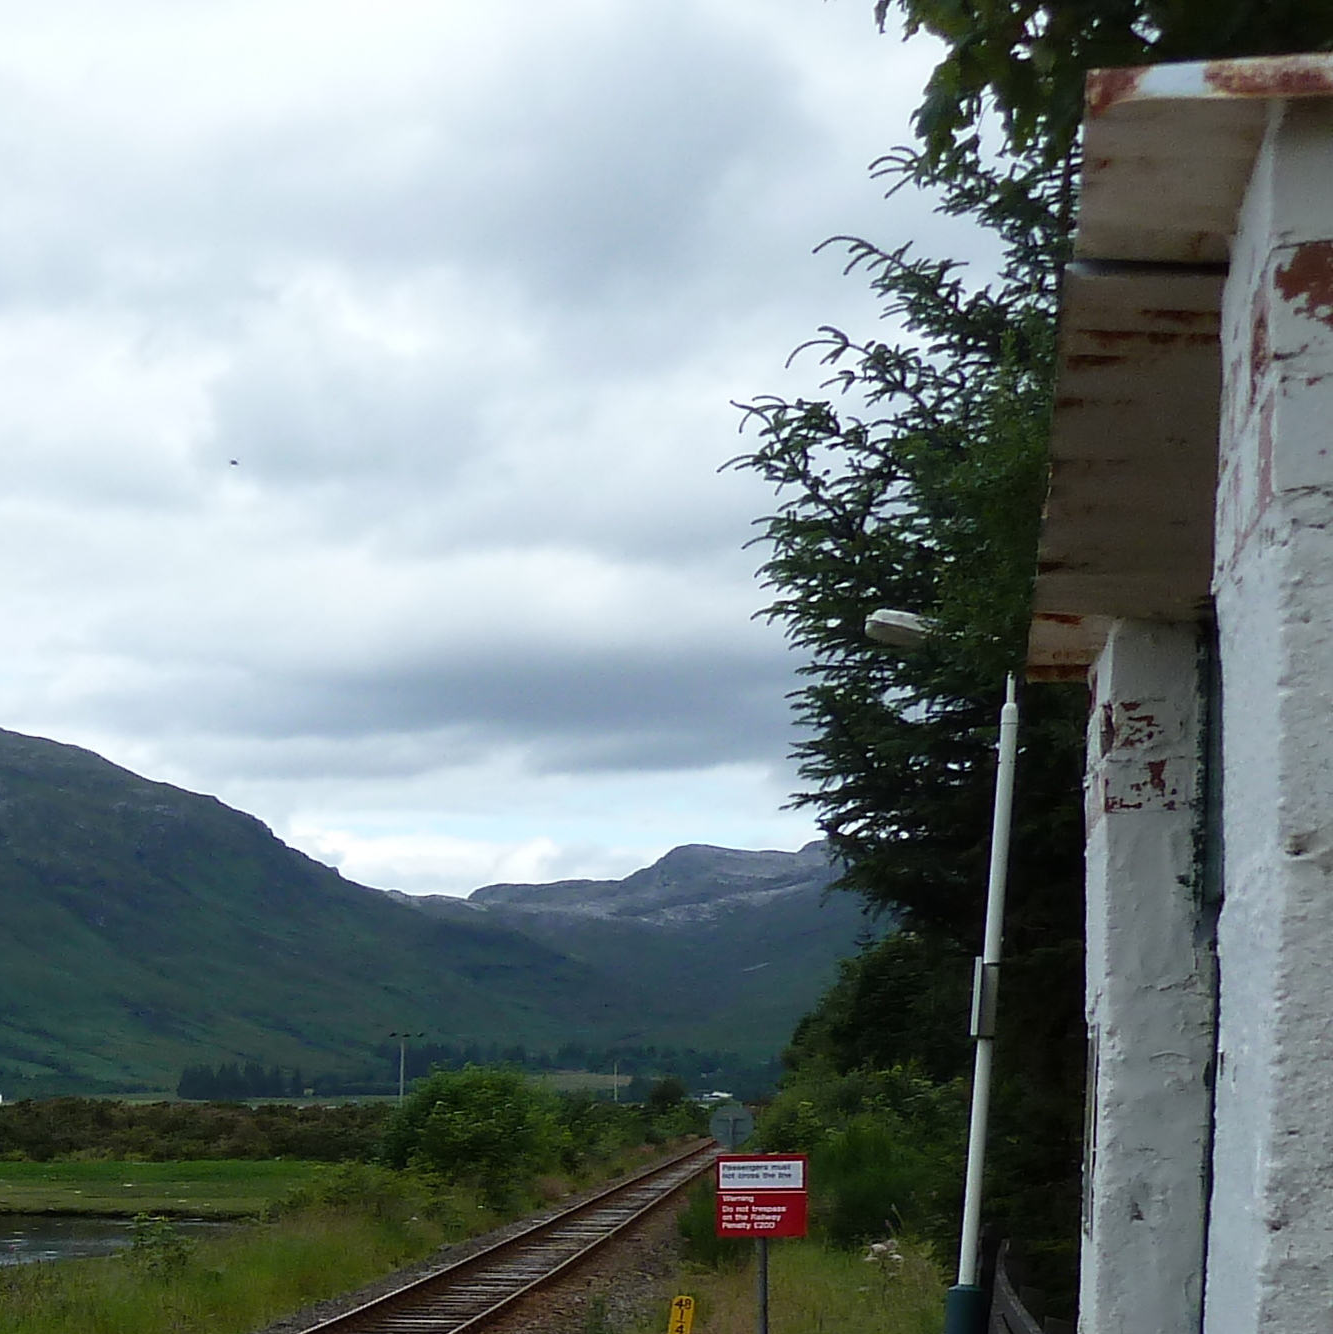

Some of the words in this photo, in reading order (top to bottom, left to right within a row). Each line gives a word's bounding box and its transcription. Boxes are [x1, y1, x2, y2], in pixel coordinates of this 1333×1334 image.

[722, 1195, 754, 1203] Warning
[752, 1205, 787, 1213] trespass
[750, 1213, 782, 1222] Railway
[722, 1222, 752, 1230] Penalty
[674, 1298, 692, 1310] 48
